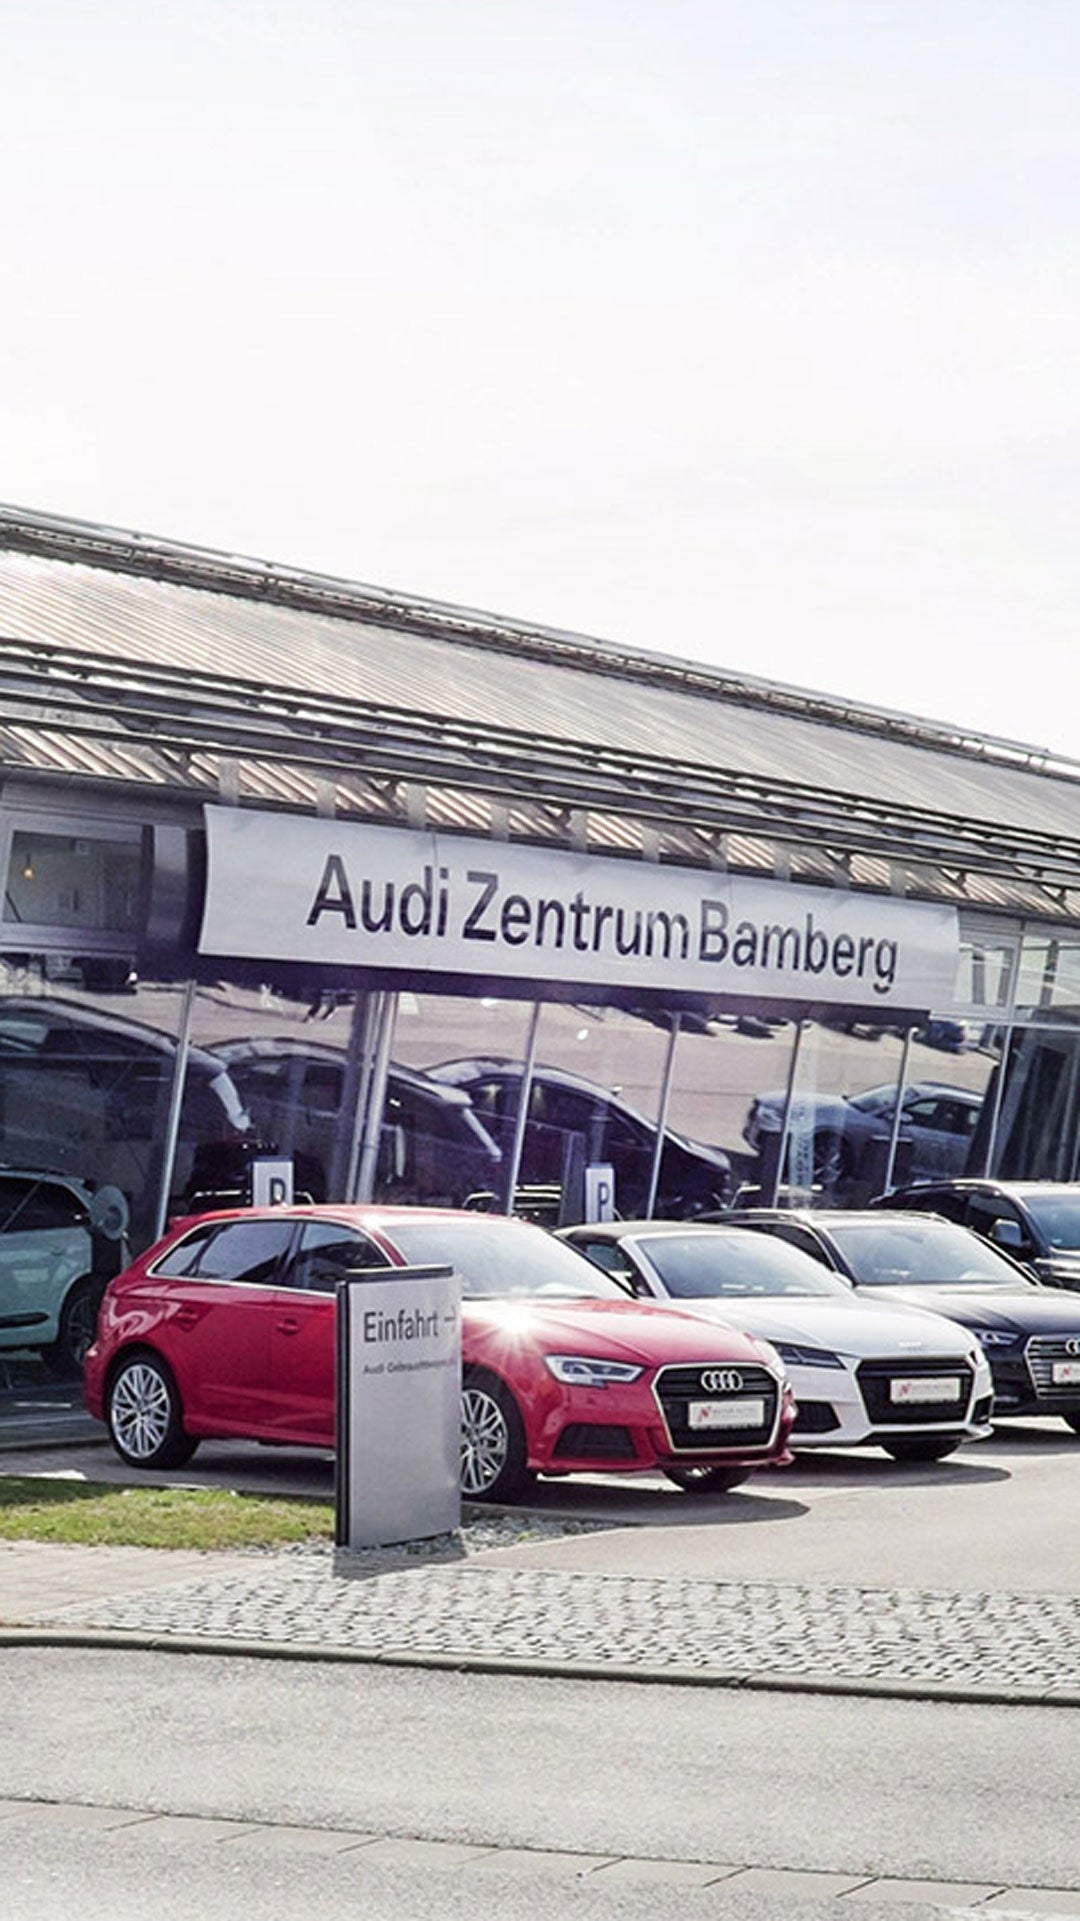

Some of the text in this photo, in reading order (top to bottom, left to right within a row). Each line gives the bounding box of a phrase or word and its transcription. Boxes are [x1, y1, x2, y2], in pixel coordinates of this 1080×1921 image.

[306, 854, 899, 994] Audi Zentrum Bamberg
[598, 1182, 610, 1222] P
[364, 1308, 438, 1342] Einfahrt
